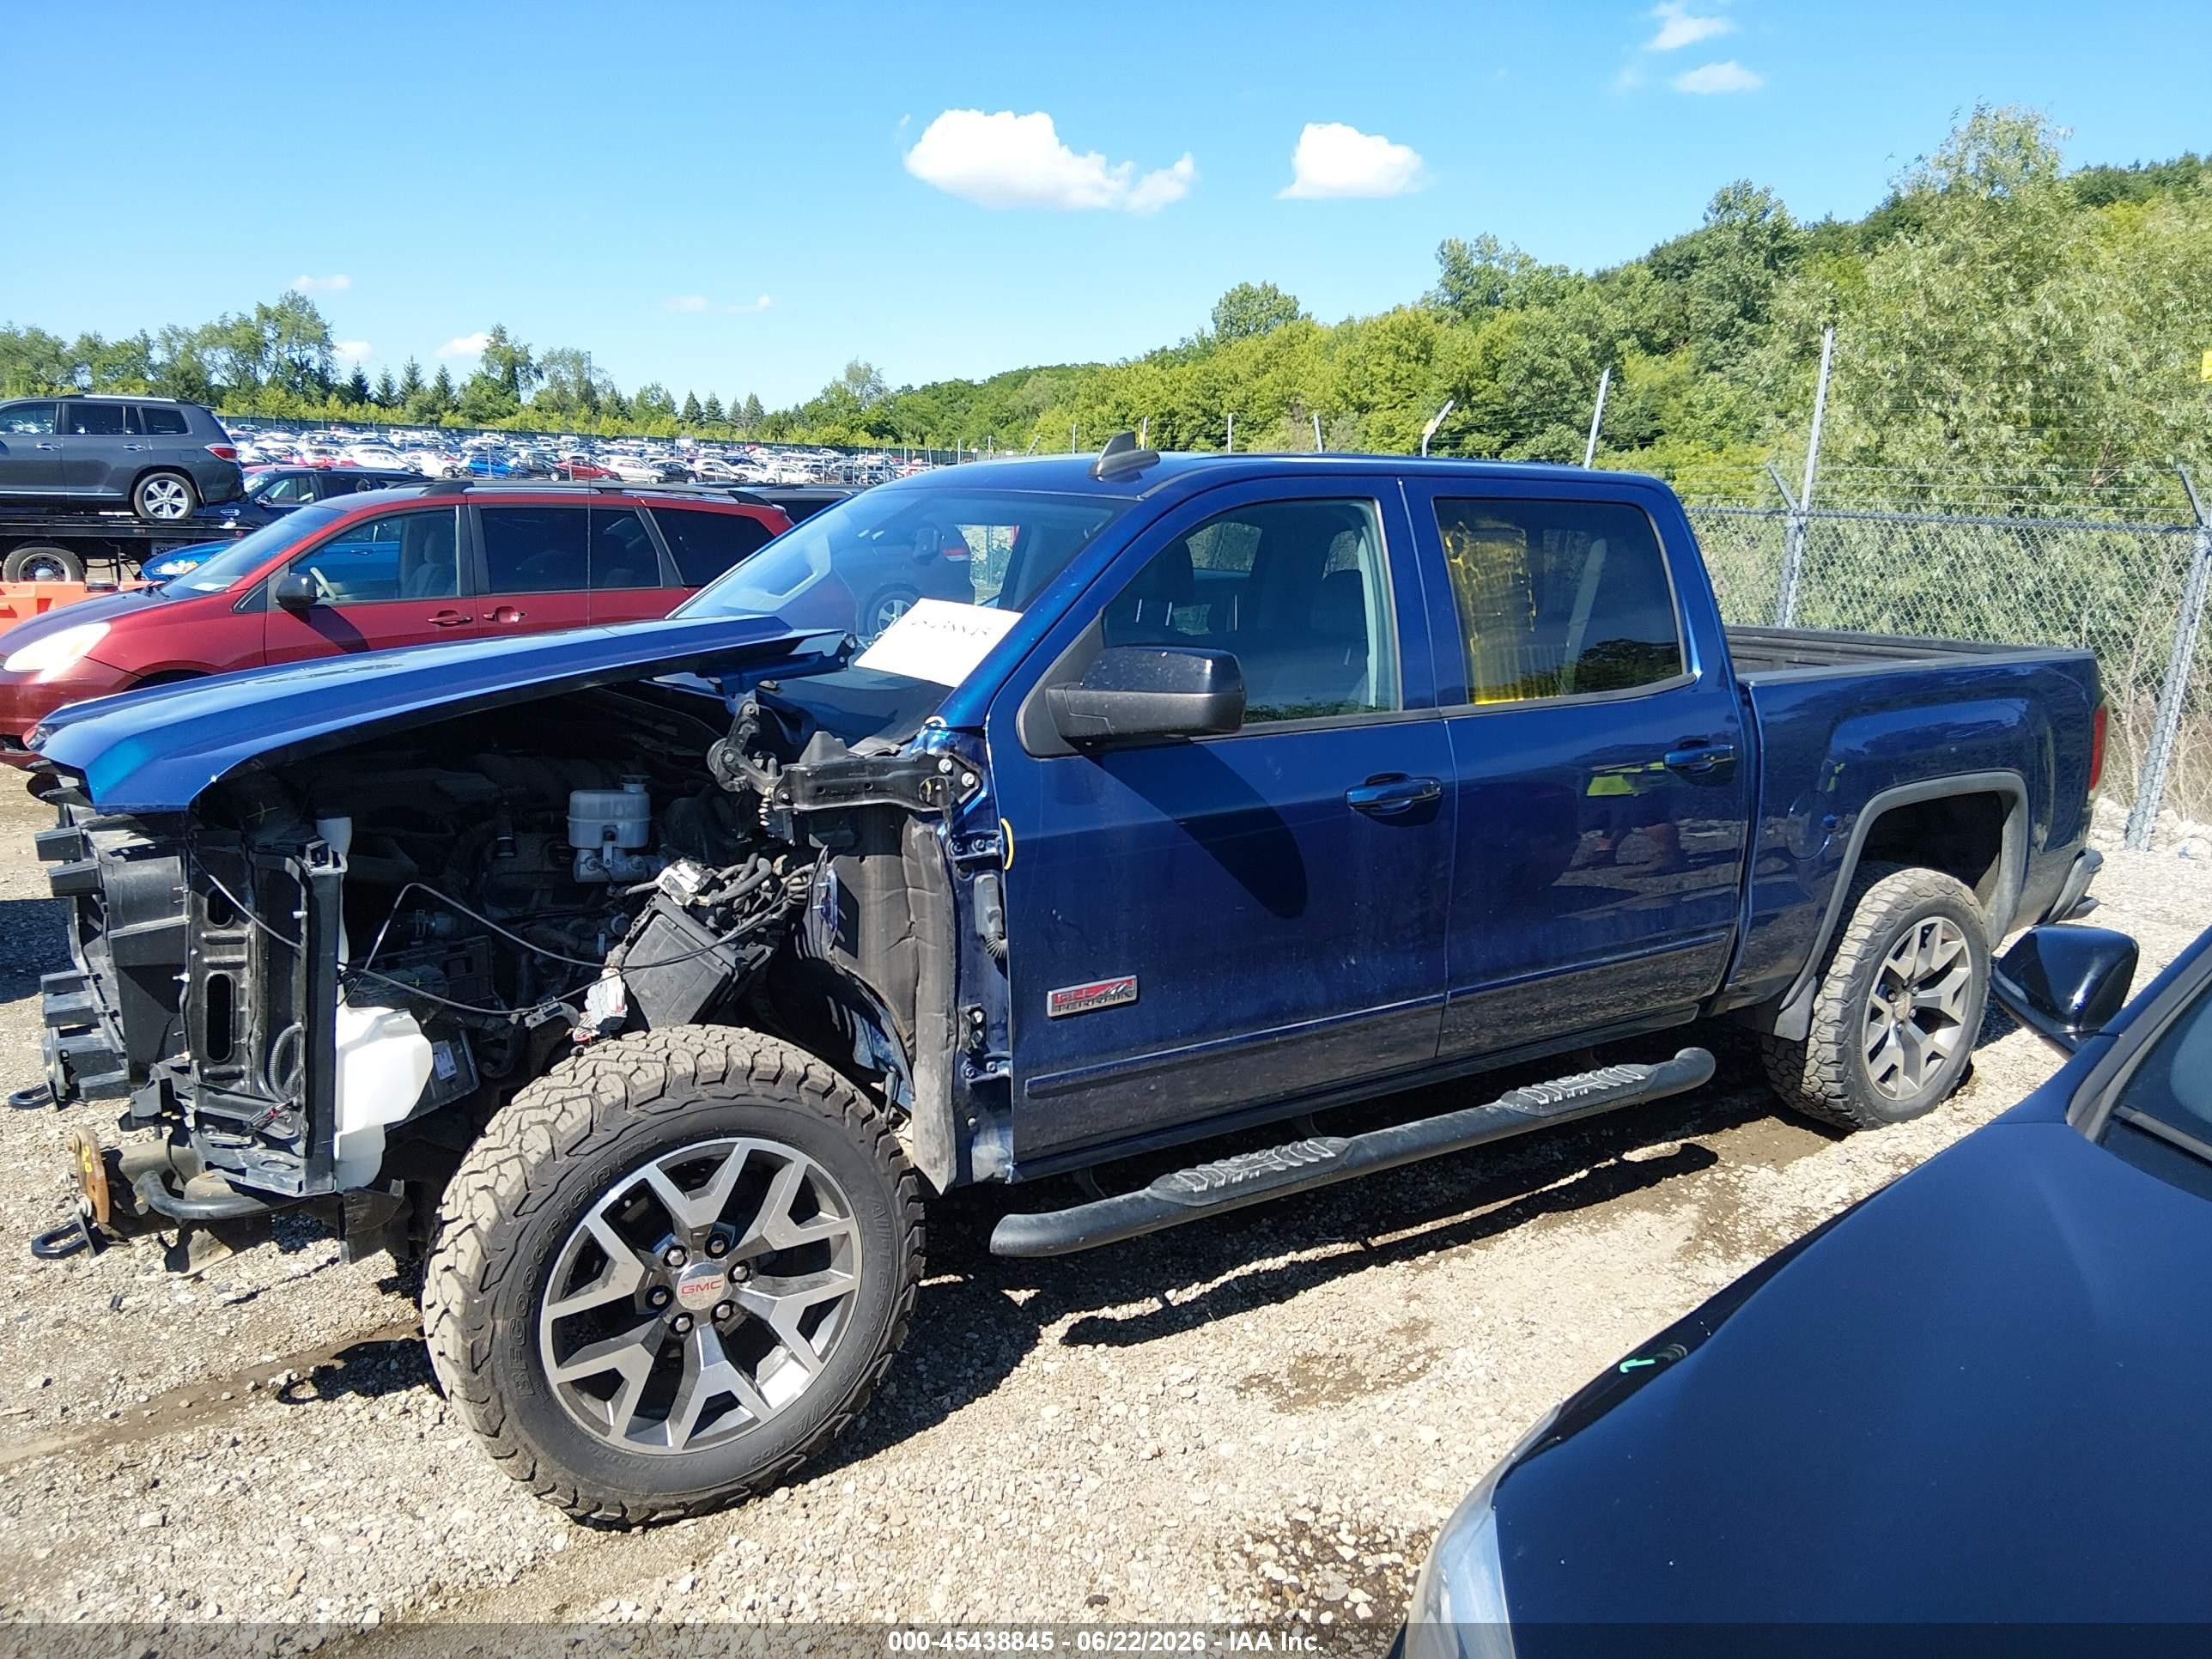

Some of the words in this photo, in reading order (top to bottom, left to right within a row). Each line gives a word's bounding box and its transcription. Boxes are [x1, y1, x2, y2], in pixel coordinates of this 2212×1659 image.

[1055, 993, 1134, 1012] TERRAIN
[507, 1163, 612, 1397] BFGoodrich
[680, 1279, 723, 1295] GMC
